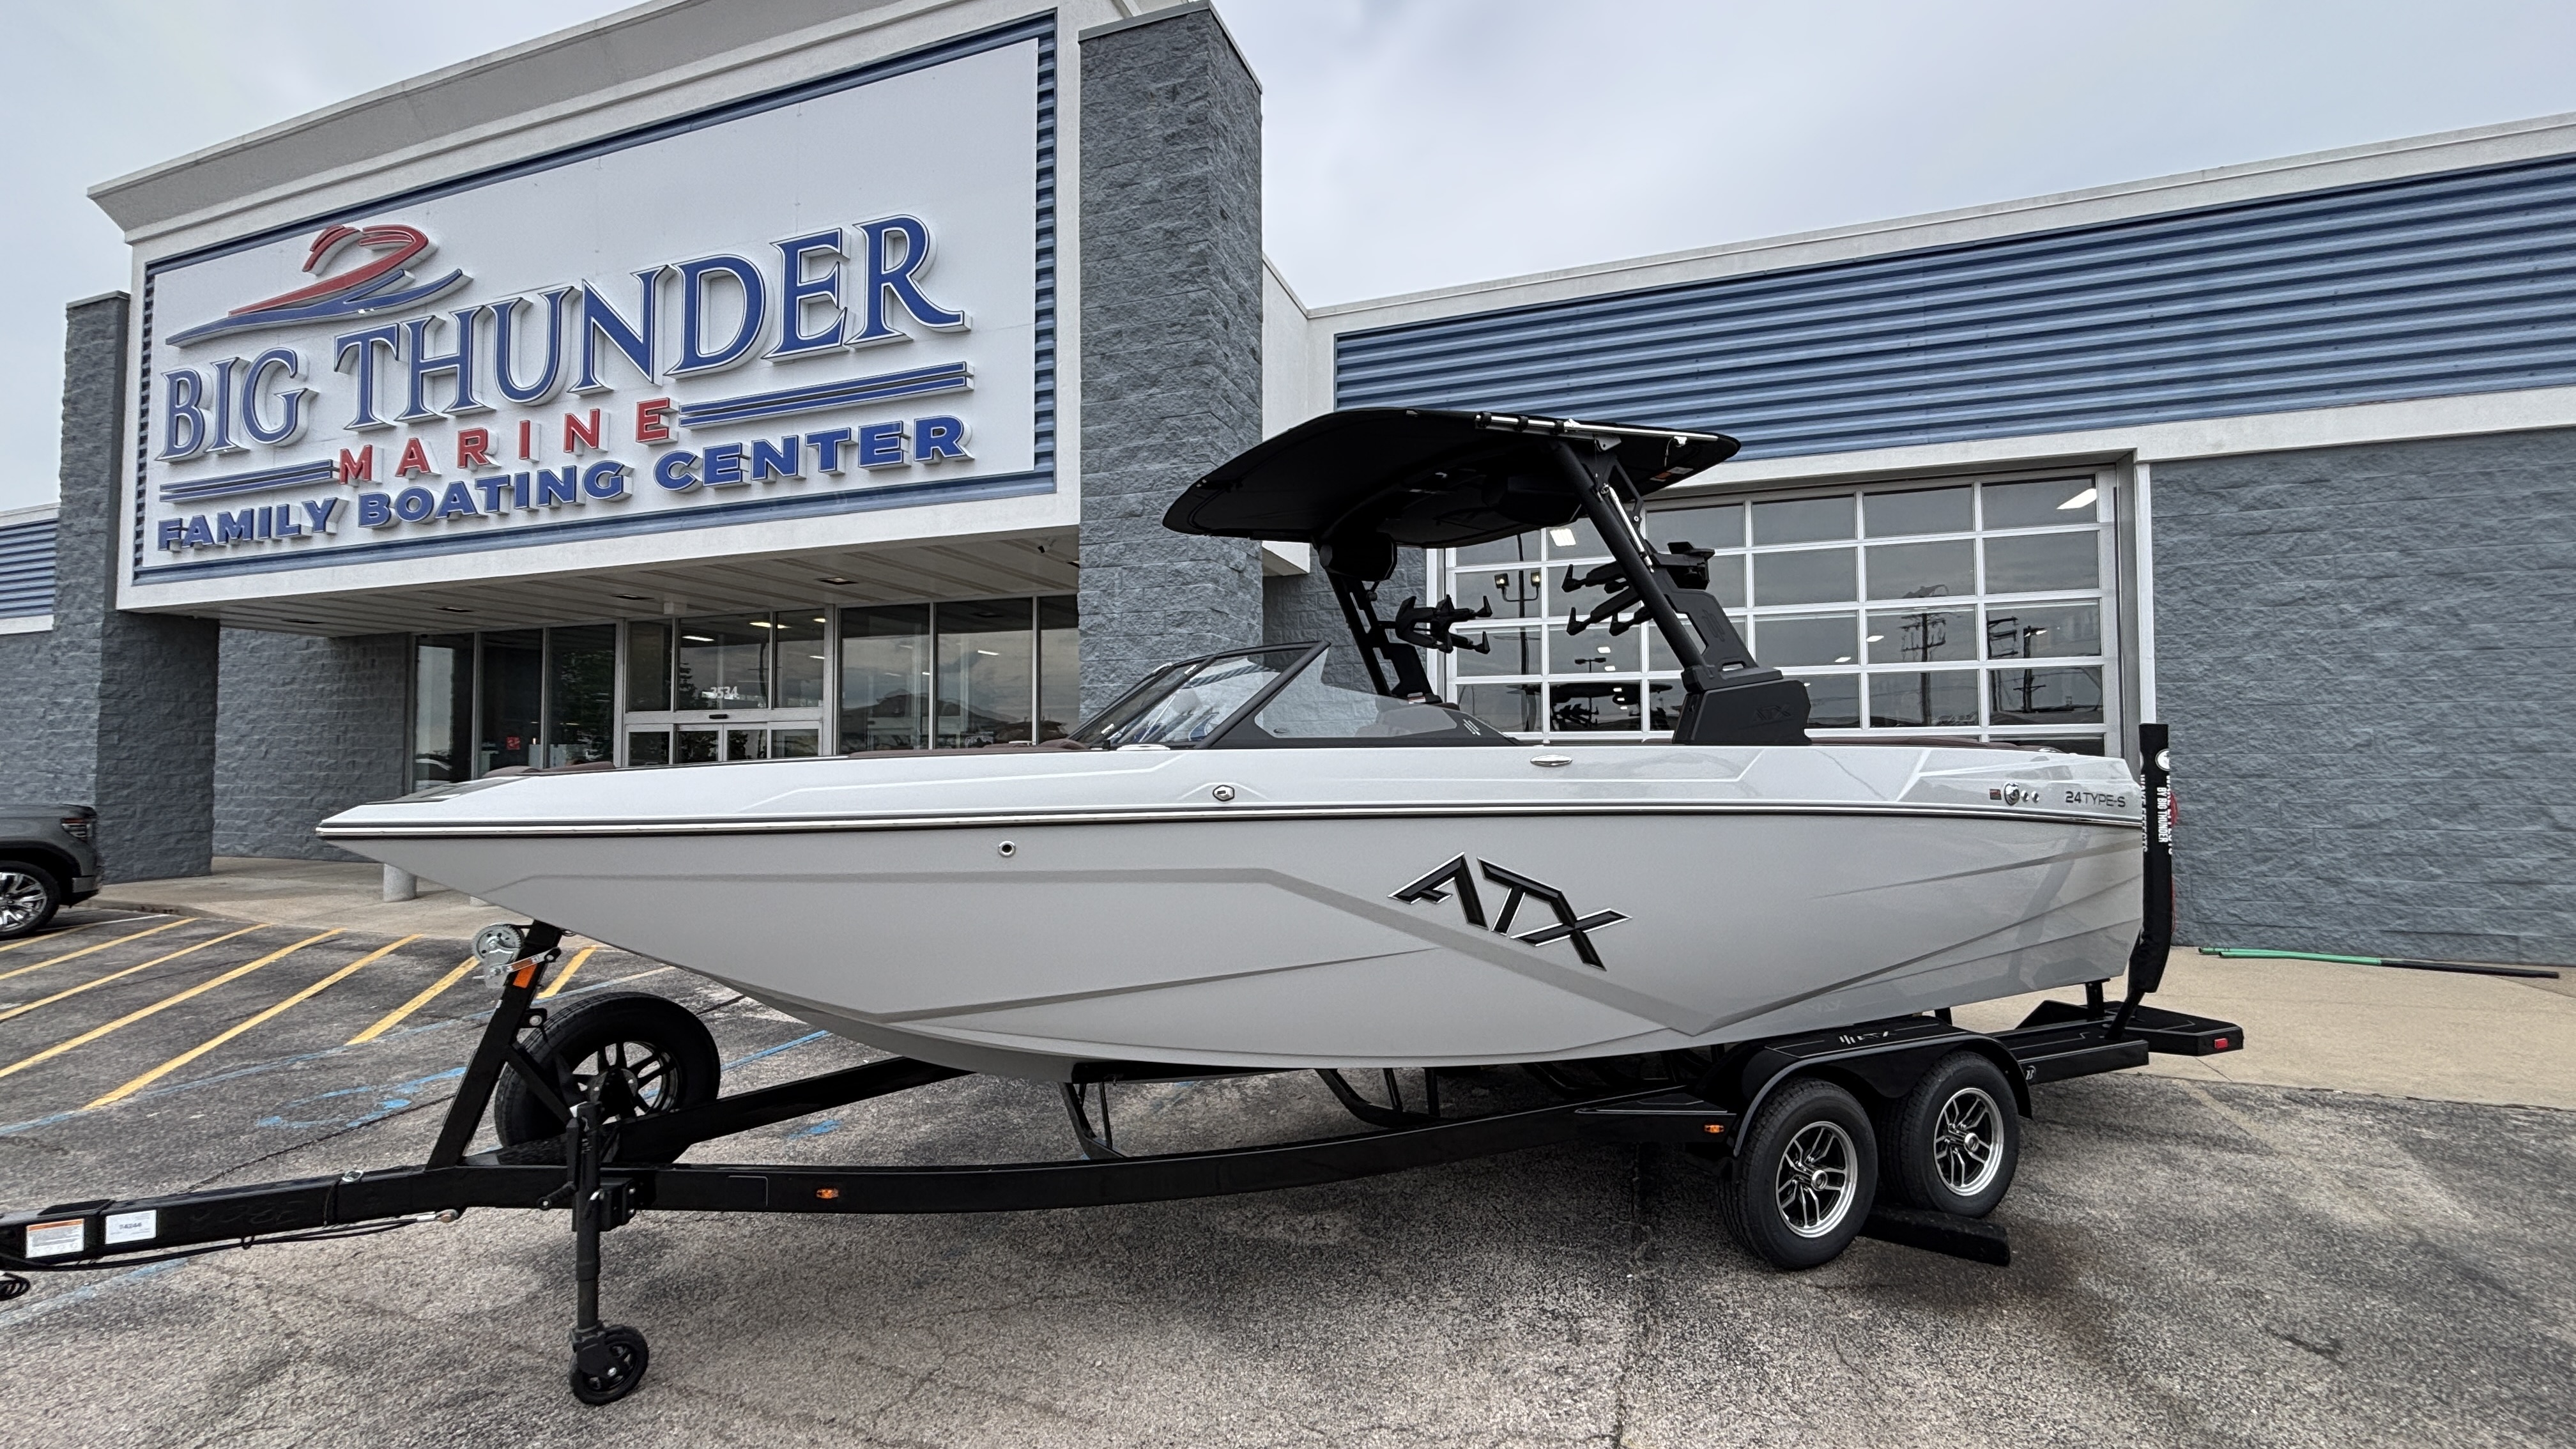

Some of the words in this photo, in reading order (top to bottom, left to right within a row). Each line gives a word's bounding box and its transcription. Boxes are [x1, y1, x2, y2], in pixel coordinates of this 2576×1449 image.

[155, 347, 310, 462] BIG
[334, 214, 965, 431] THUNDER
[339, 397, 671, 485] MARINE
[158, 498, 339, 551] FAMILY
[358, 460, 625, 528] BOATING
[653, 415, 966, 492] CENTER
[710, 686, 740, 700] 3534
[1752, 703, 1792, 723] ATX
[2156, 786, 2167, 797] BY
[2157, 799, 2168, 809] BIG
[2157, 811, 2169, 843] THUNDER
[1387, 851, 1633, 972] ATX
